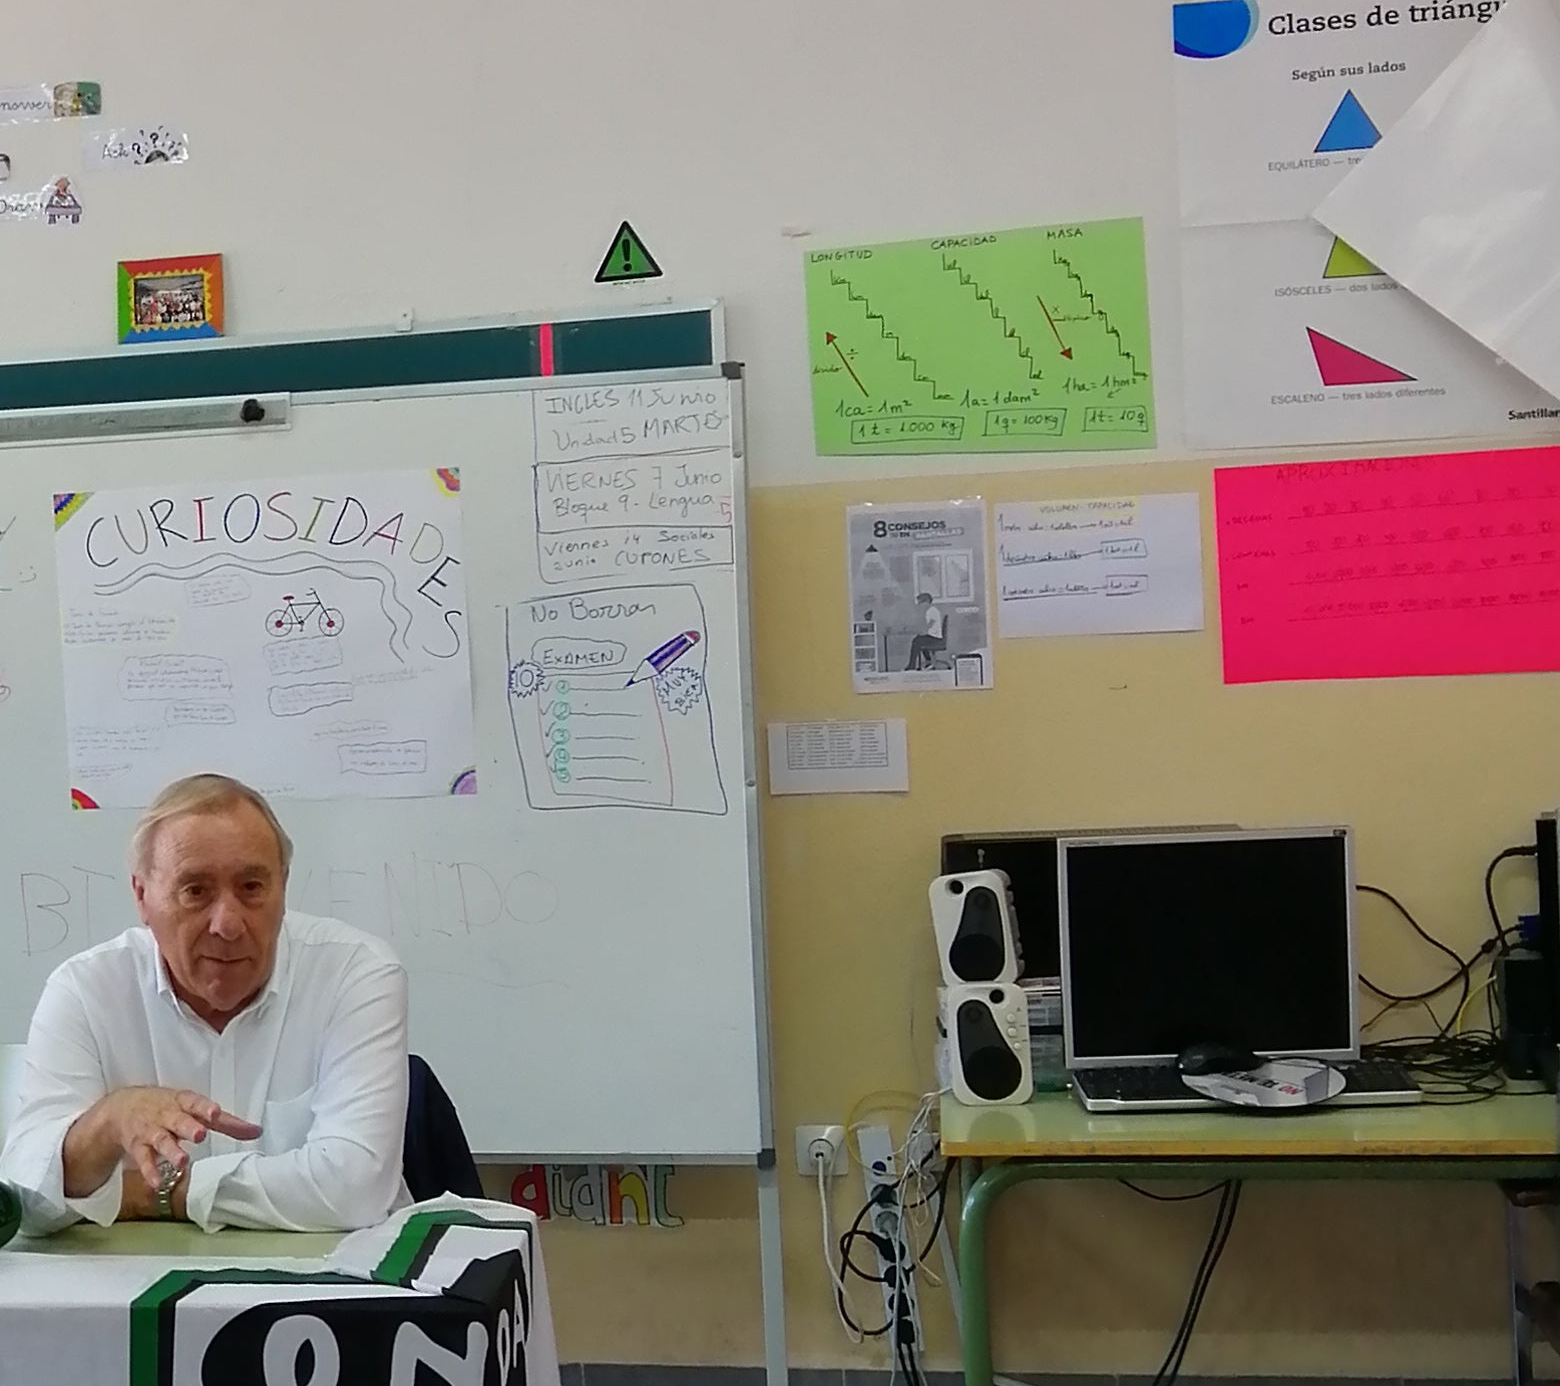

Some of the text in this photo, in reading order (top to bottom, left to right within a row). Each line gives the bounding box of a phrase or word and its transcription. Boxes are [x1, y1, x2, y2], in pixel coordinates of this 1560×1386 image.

[1268, 13, 1357, 36] Clases
[1366, 5, 1400, 28] de
[1291, 60, 1407, 82] Según sus lados
[1267, 156, 1331, 172] EQUILÁTERO
[810, 227, 1083, 264] LONGITUD CAPACIDAD MASA
[1274, 284, 1332, 297] ISÓSCELES
[1370, 281, 1398, 292] lados
[545, 389, 620, 414] INGLES
[1271, 386, 1446, 406] ESCALENO tres lados diferentes
[621, 426, 636, 444] 5
[546, 464, 722, 492] VIERNES 7 Junio
[552, 497, 608, 523] Bloque
[649, 492, 715, 518] Lengua
[873, 520, 947, 538] 8 CONSEJOS
[544, 539, 609, 556] Viernes
[657, 530, 715, 543] Sociales
[614, 548, 711, 567] CUPONES
[86, 491, 462, 659] CURIOSIDADES
[531, 605, 558, 622] No
